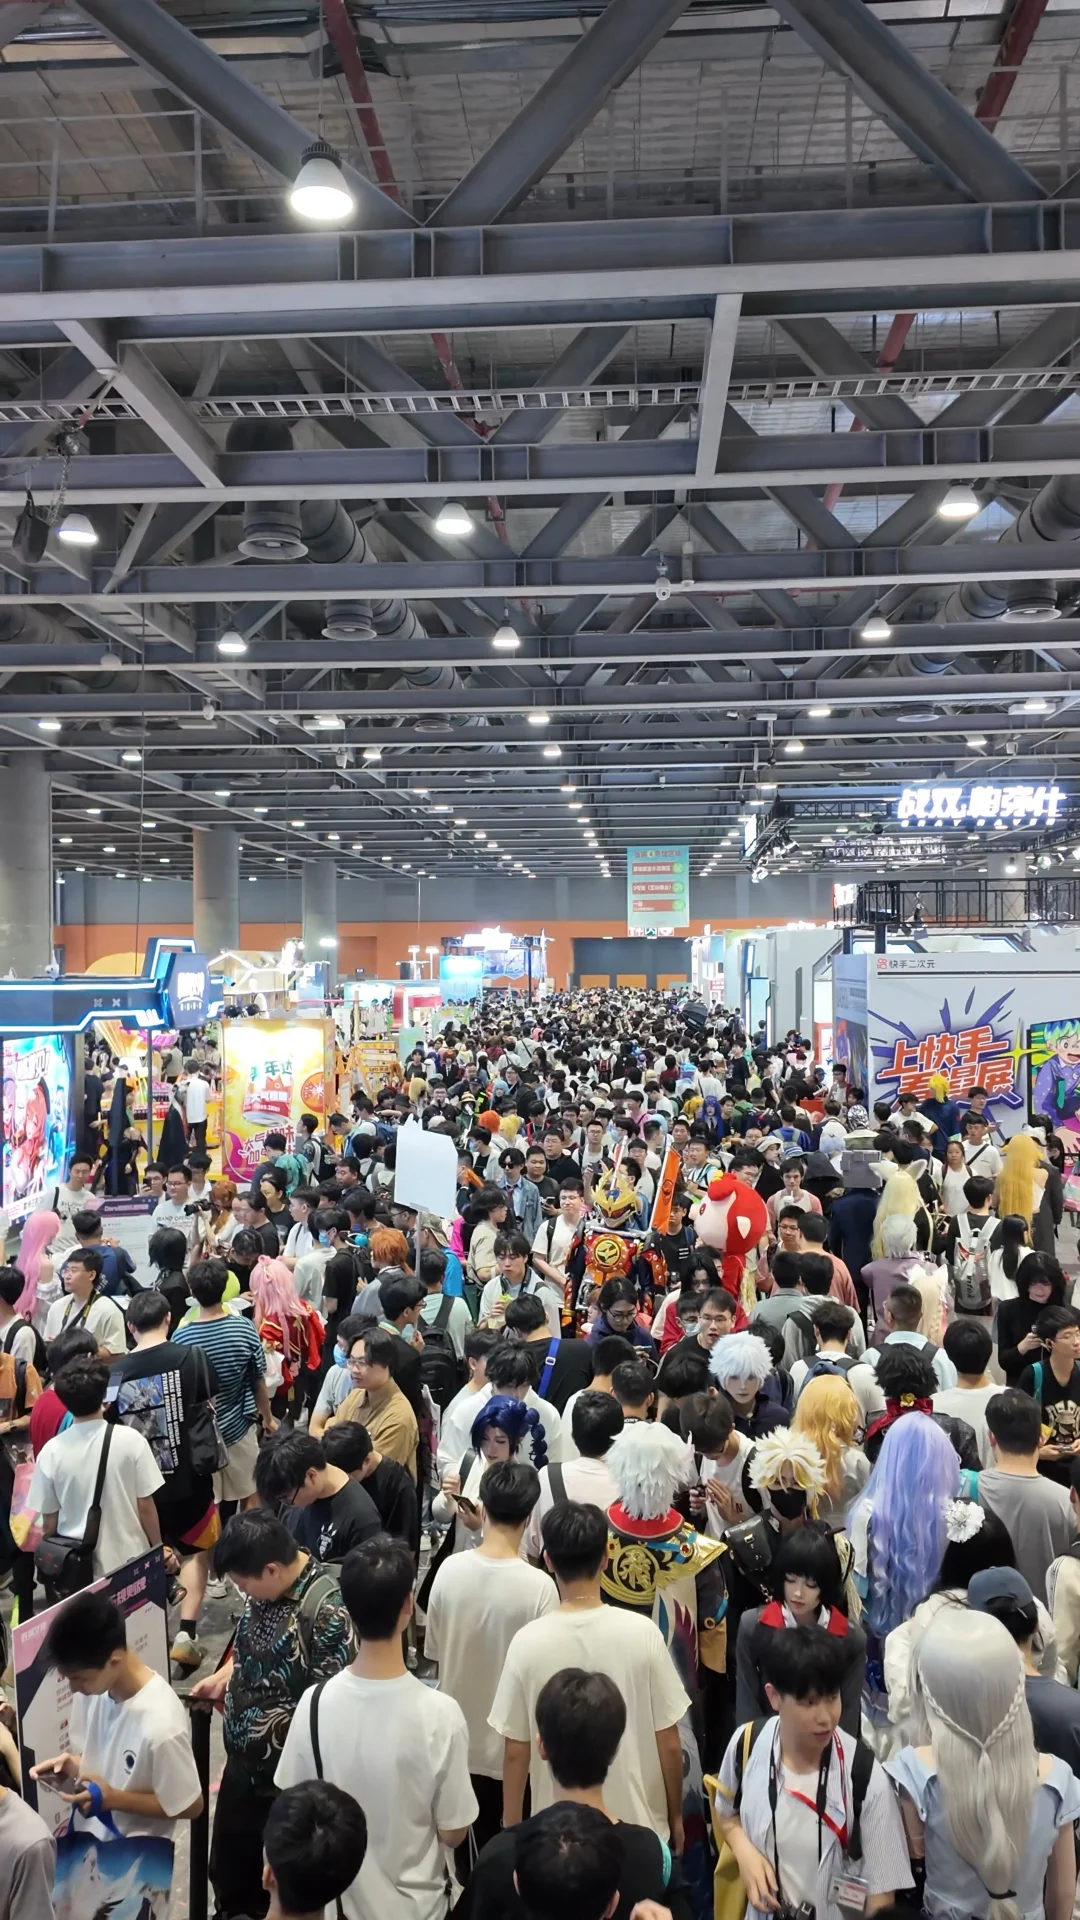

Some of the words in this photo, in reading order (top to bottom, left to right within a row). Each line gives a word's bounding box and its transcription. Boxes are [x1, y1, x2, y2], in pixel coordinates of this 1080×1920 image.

[889, 959, 935, 969] 快手二次元
[877, 1025, 1008, 1078] 上快手
[174, 1369, 182, 1397] FREEDOM
[164, 1395, 172, 1422] FREEDOM
